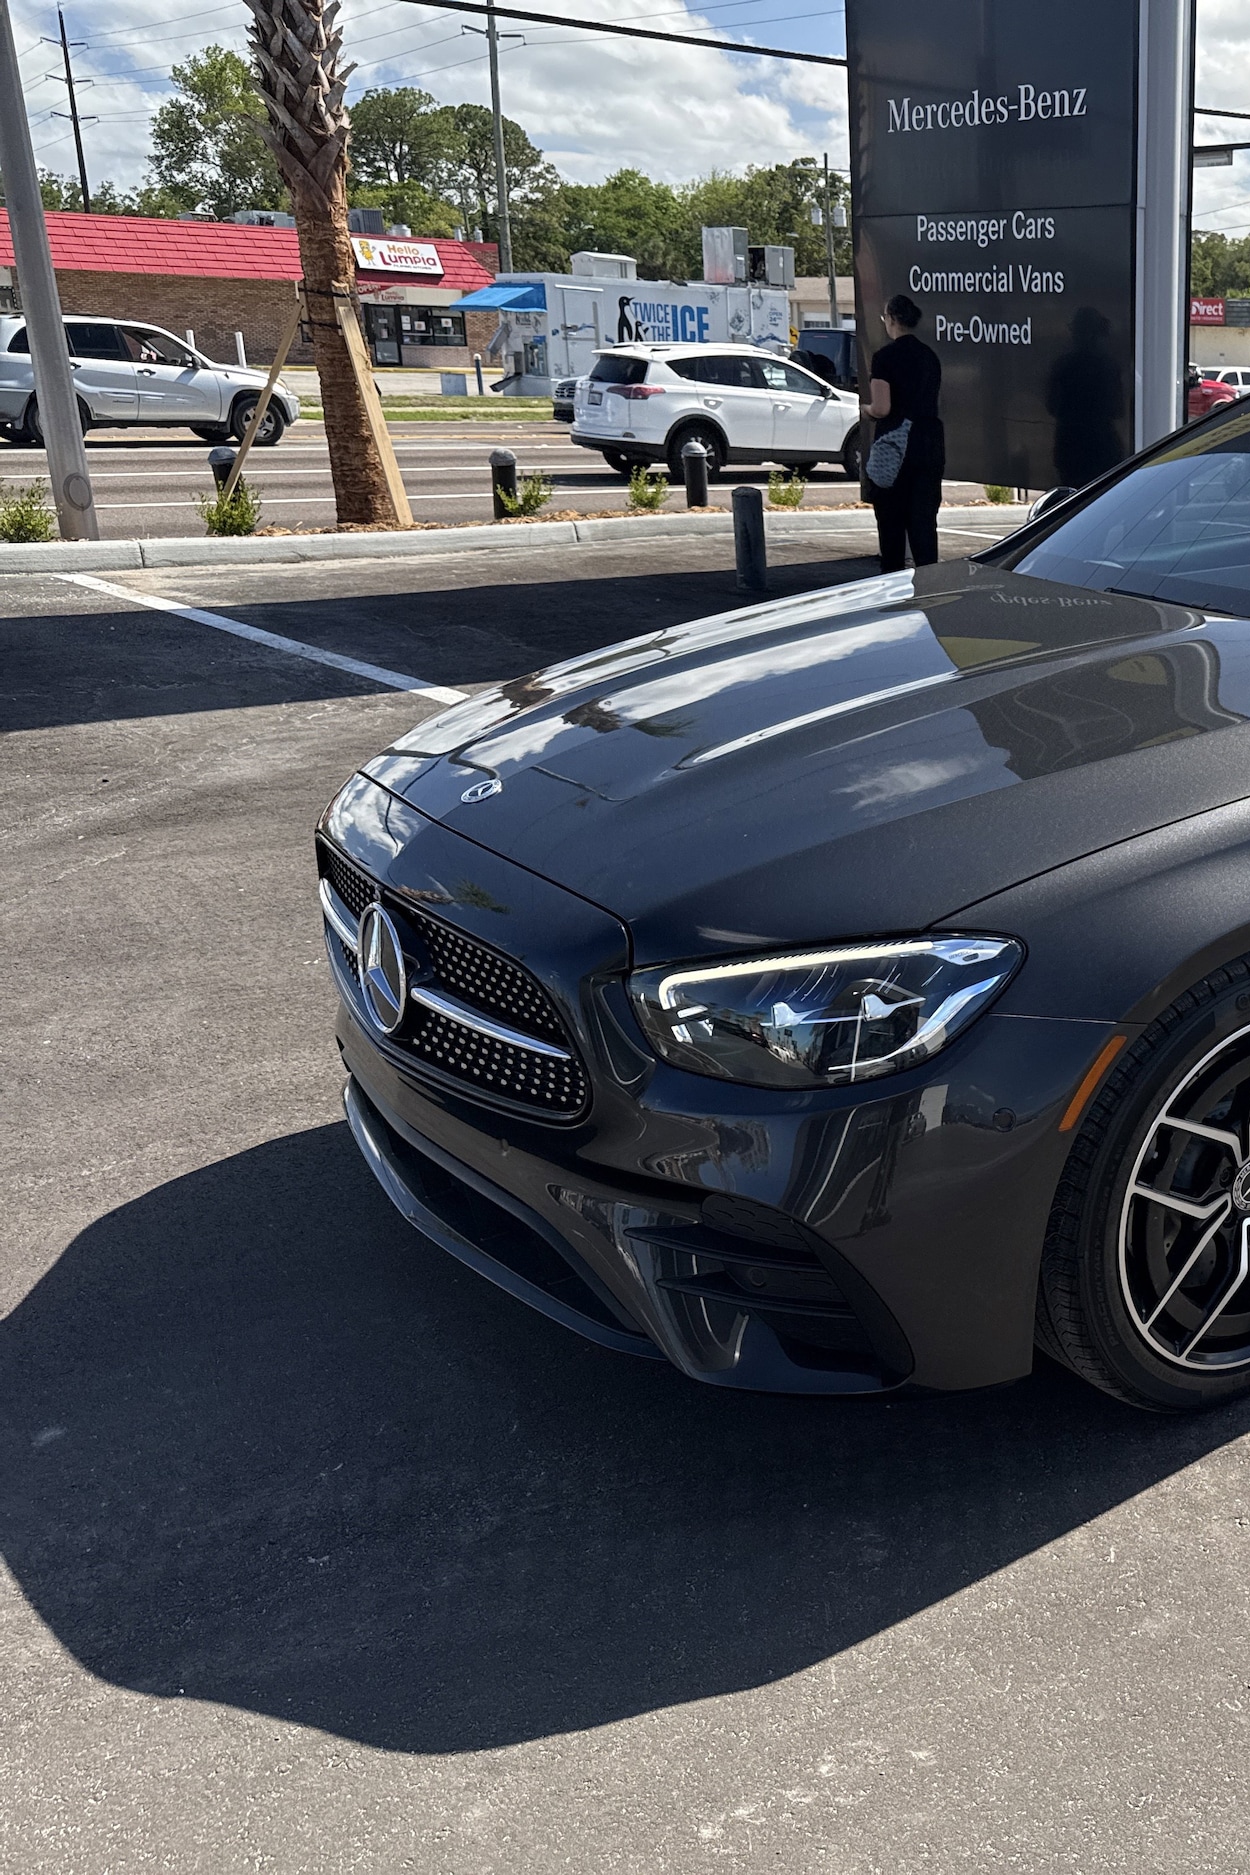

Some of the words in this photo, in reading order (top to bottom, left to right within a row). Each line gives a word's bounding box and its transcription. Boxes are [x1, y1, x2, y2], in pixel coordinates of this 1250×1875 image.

[887, 84, 1087, 133] Mercedes-Benz
[917, 214, 1007, 248] Passenger
[1012, 210, 1055, 240] Cars
[379, 251, 437, 266] Lumpia
[386, 244, 420, 256] Hello
[909, 264, 1013, 293] Commercial
[1018, 264, 1065, 294] Vans
[632, 302, 670, 324] TWICE
[671, 305, 710, 343] ICE
[651, 325, 671, 342] THE
[935, 314, 1032, 345] Pre-Owned
